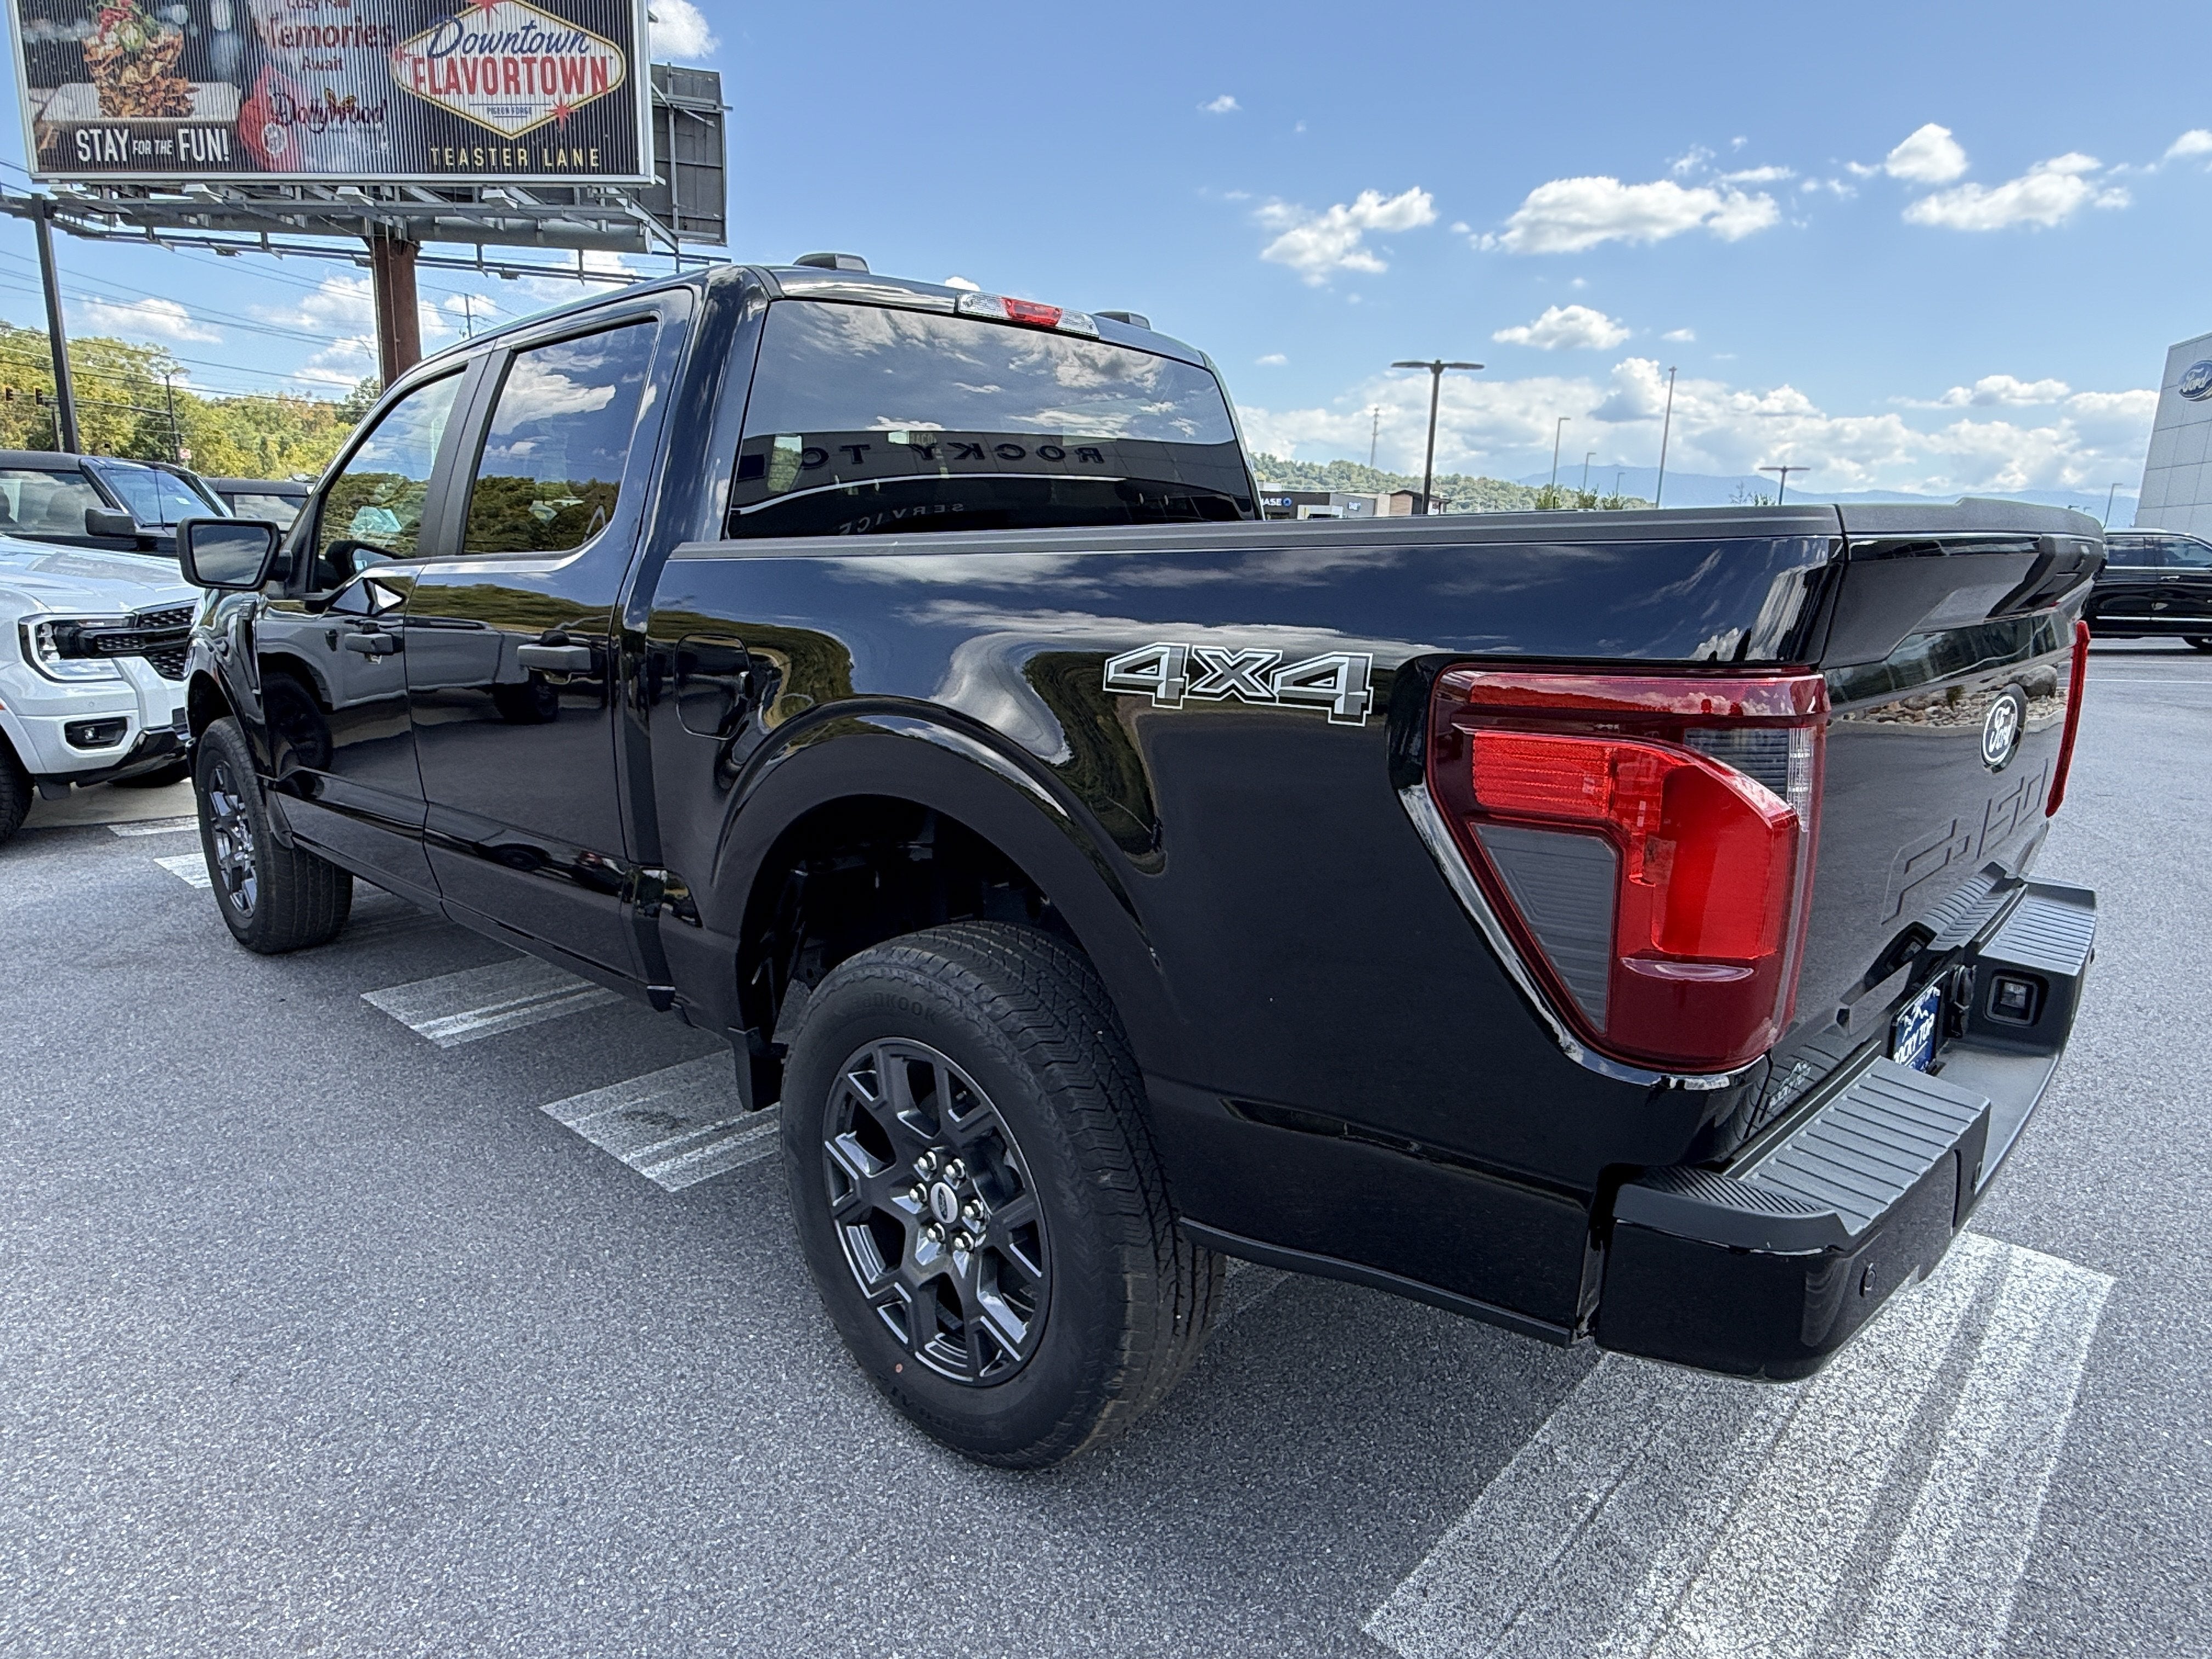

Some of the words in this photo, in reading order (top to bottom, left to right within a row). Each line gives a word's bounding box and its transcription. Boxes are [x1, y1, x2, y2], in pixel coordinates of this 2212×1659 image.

[427, 15, 590, 58] Downtown
[302, 56, 344, 71] Await
[413, 55, 608, 96] FLAVORTOWN
[76, 128, 129, 161] STAY
[132, 139, 151, 155] FOR
[155, 139, 173, 155] THE
[178, 128, 230, 162] FUN!
[430, 147, 528, 167] TEASTER
[543, 147, 600, 167] LANE
[2182, 368, 2209, 393] Ford
[1988, 706, 2013, 753] Ford
